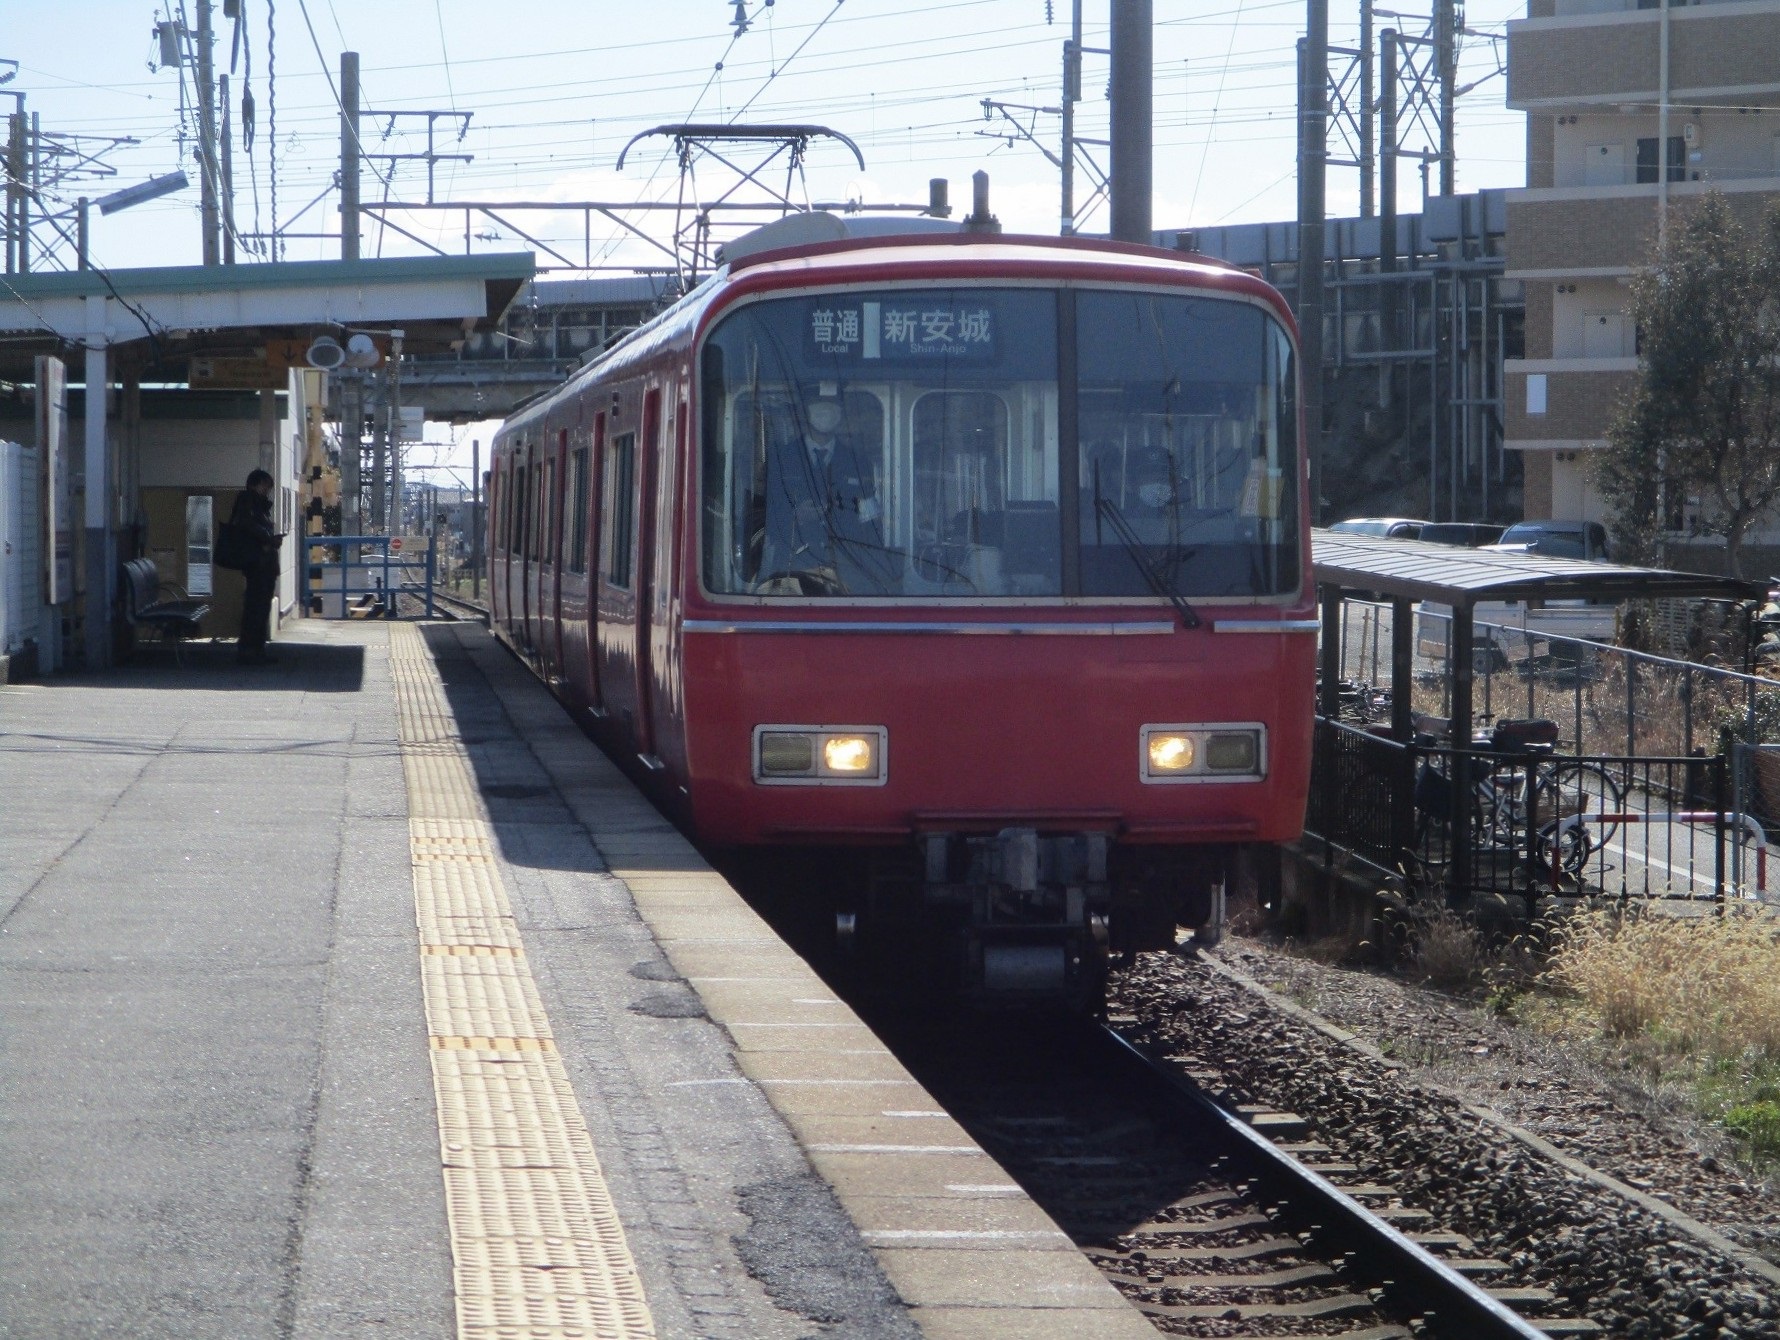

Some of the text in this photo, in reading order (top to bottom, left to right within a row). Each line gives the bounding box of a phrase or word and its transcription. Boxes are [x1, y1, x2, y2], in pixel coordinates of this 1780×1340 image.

[812, 309, 859, 343] 普通
[884, 309, 991, 343] 新安城
[821, 343, 849, 353] Local
[910, 343, 967, 355] Shin-Anjo
